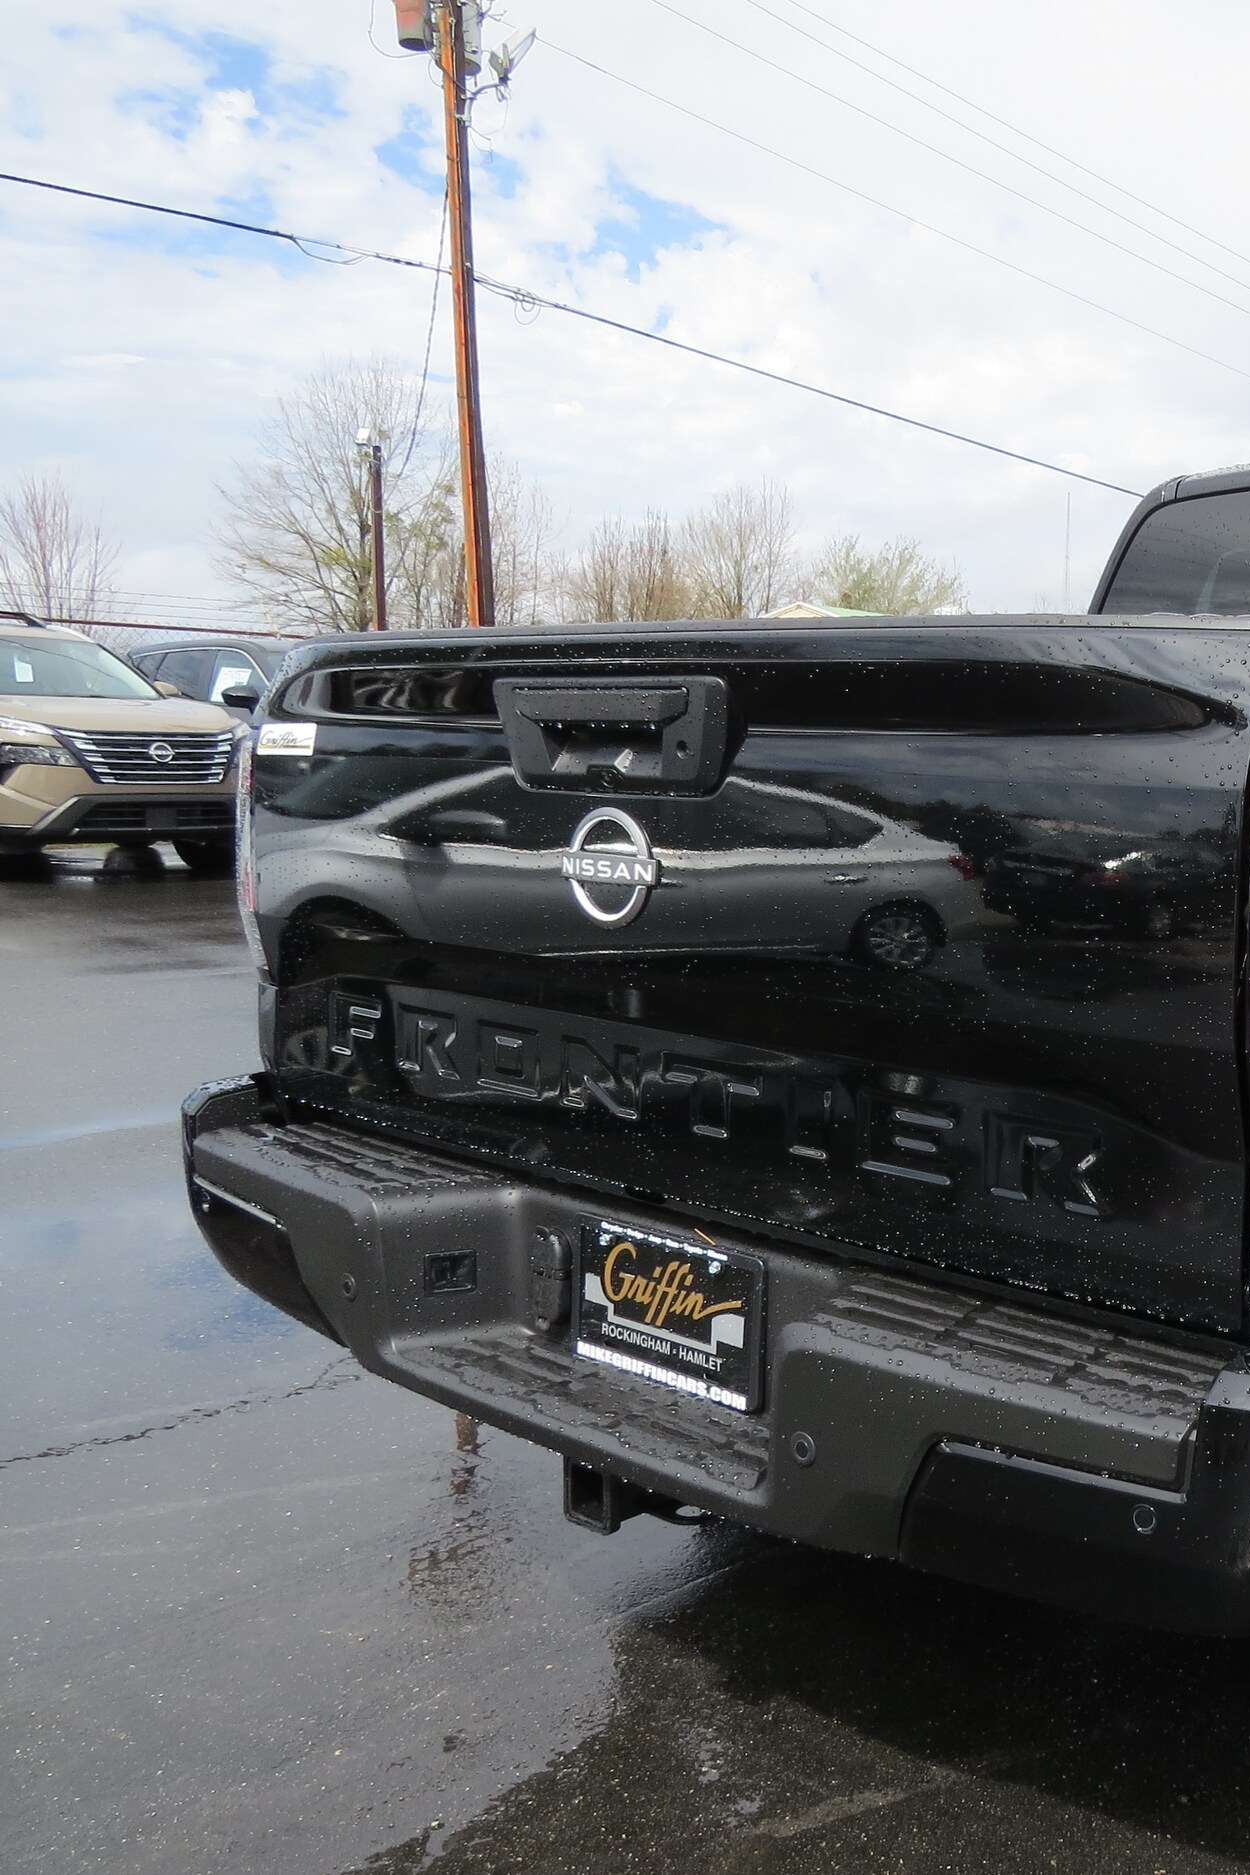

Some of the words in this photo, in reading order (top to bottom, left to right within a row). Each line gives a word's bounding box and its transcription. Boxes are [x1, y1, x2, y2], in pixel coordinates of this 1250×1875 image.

[562, 856, 652, 882] NISSAN
[328, 990, 1106, 1217] FRONTIER
[604, 1242, 742, 1327] Griffin
[577, 1340, 747, 1411] MIKEGRIFFINCARS.COM
[602, 1322, 671, 1355] ROCKINGHAM
[679, 1346, 723, 1372] HAMLET
